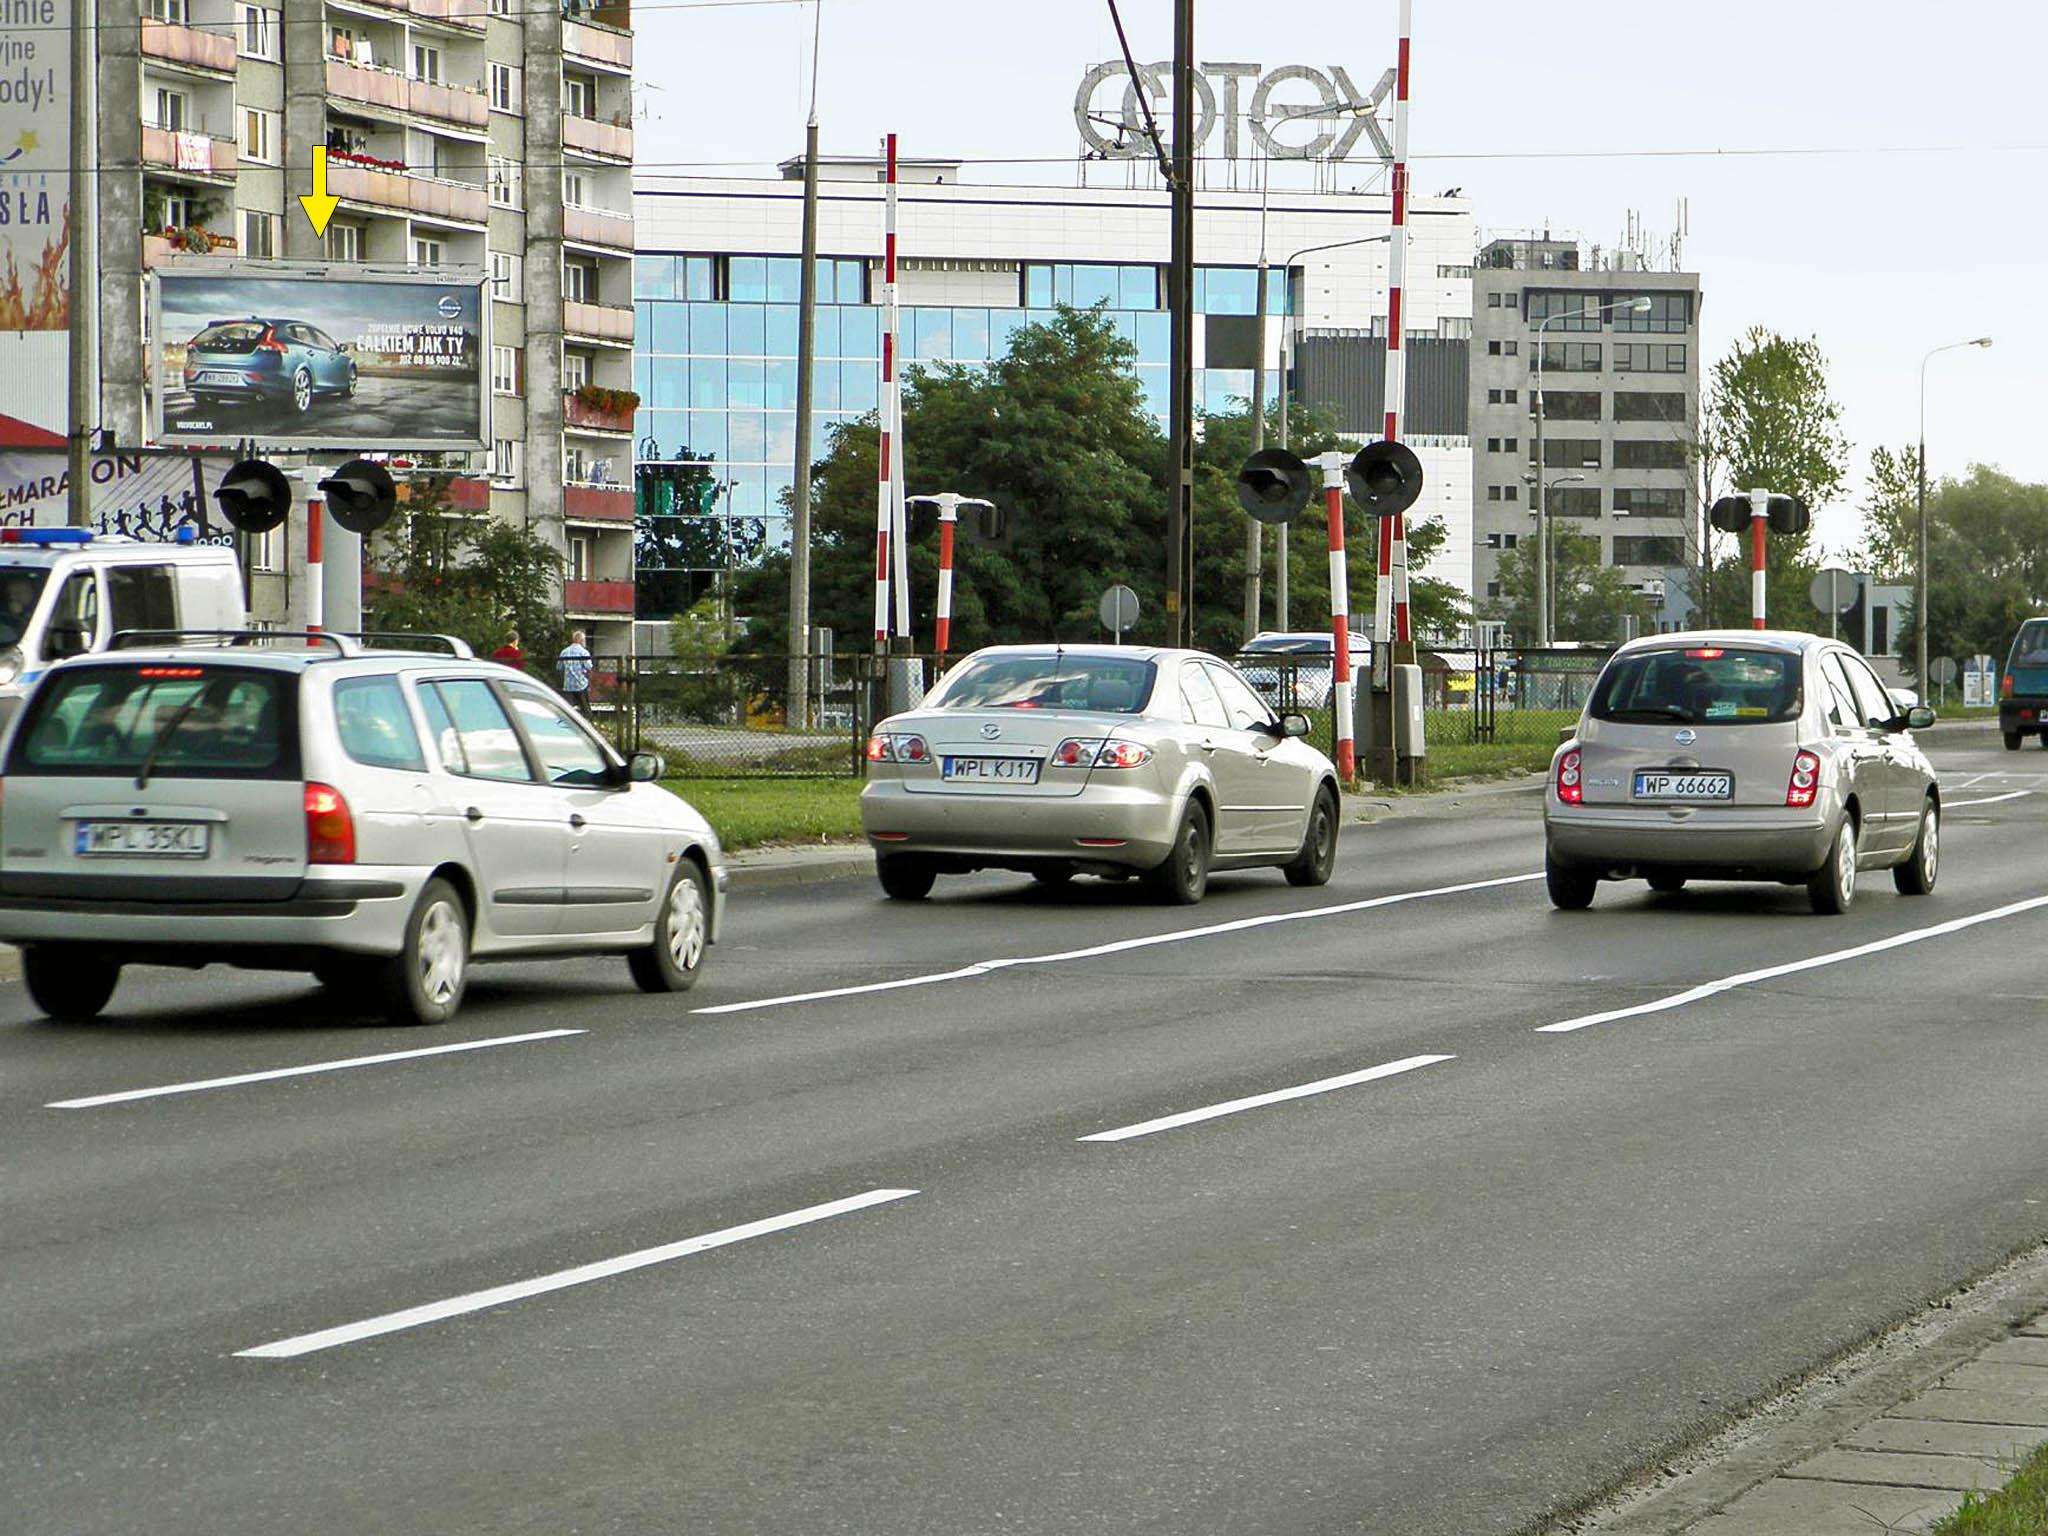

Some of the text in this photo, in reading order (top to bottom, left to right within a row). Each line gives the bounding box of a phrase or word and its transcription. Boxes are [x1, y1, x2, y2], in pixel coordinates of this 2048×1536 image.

[0, 0, 54, 24] lnie
[0, 34, 35, 67] jne
[0, 66, 54, 112] ody!
[425, 325, 447, 335] VOLVO
[449, 325, 464, 336] V40
[356, 333, 464, 355] CAŁKIEM JAK TY
[955, 760, 1036, 778] WPL KJ17
[1646, 777, 1727, 794] WP 66662
